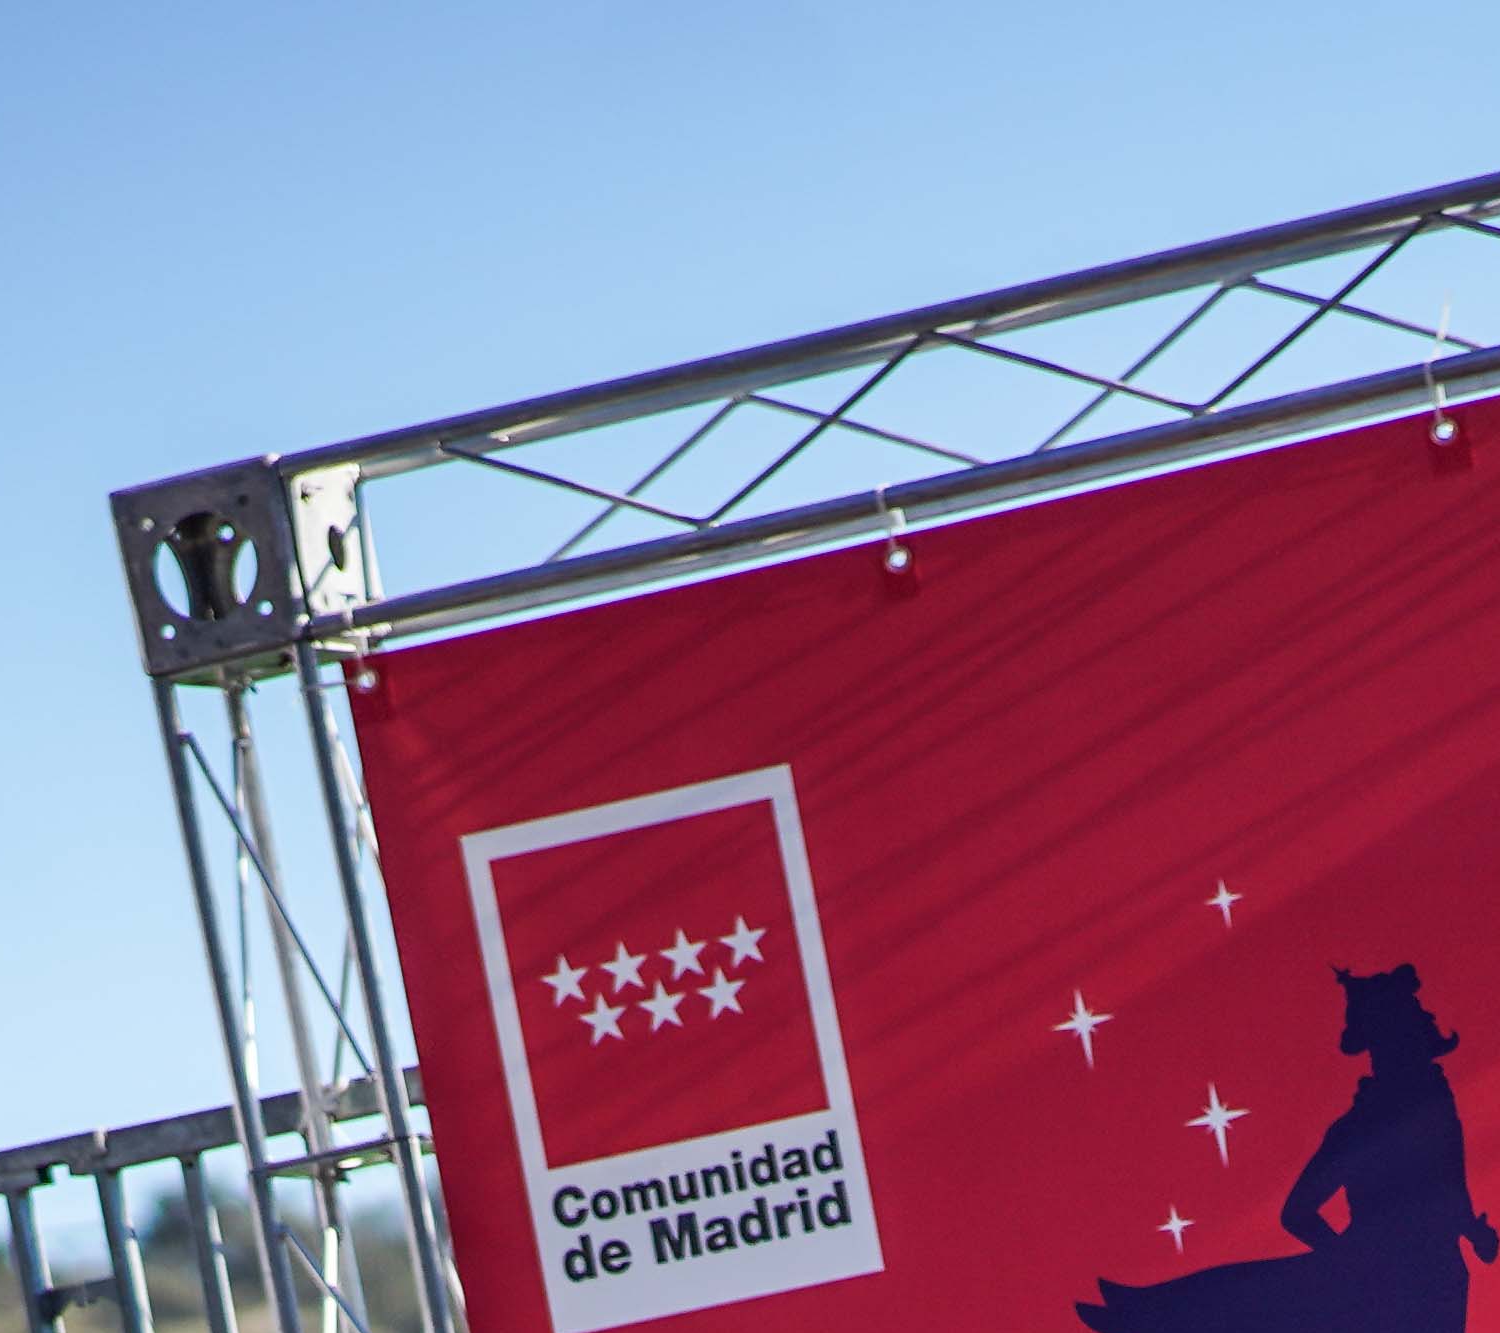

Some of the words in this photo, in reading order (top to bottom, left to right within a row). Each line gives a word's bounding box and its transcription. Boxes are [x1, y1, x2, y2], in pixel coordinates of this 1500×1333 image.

[552, 1129, 843, 1228] Comunidad
[563, 1234, 632, 1283] de
[649, 1181, 852, 1265] Madrid
